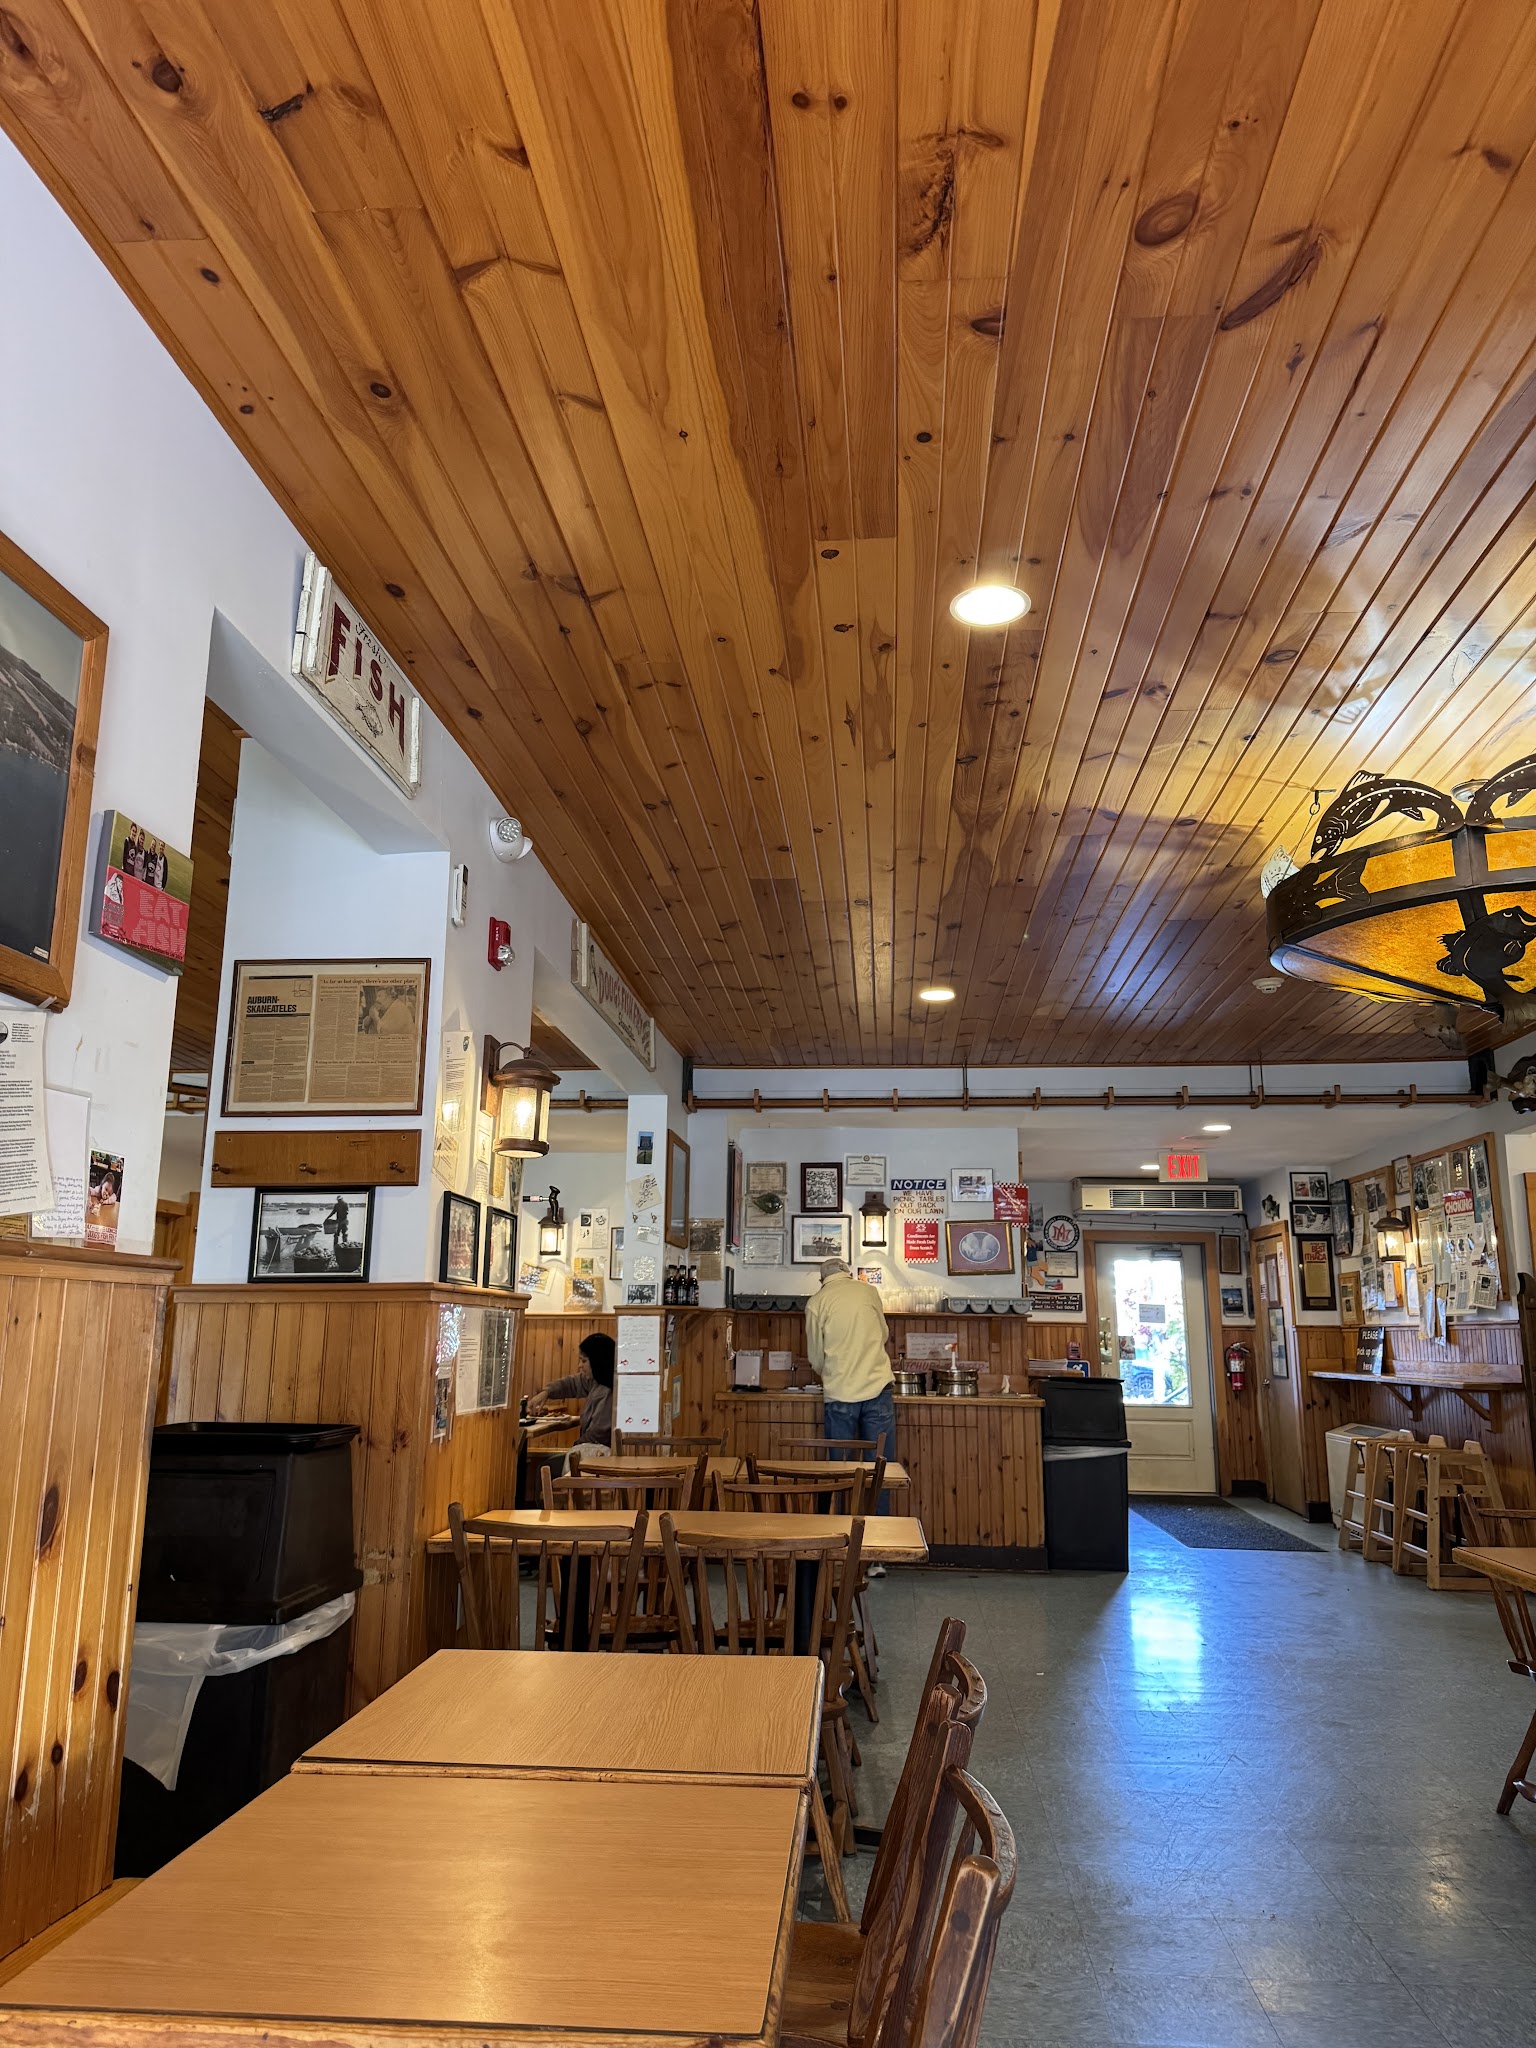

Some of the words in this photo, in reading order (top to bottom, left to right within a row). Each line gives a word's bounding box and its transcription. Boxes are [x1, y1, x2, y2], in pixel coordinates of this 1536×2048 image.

[325, 602, 405, 760] FISH
[140, 889, 183, 926] EAT
[132, 918, 187, 955] FISH
[247, 996, 280, 1005] AUBURN-
[246, 1004, 297, 1014] SKANEATELES
[1167, 1154, 1200, 1179] EXIT
[892, 1180, 945, 1190] NOTICE
[1445, 1198, 1473, 1215] CHOKING
[1304, 1253, 1327, 1261] ITHACA
[1361, 1330, 1379, 1340] PLEASE
[1357, 1346, 1365, 1357] pick
[1365, 1348, 1371, 1357] up
[1362, 1361, 1373, 1371] here
